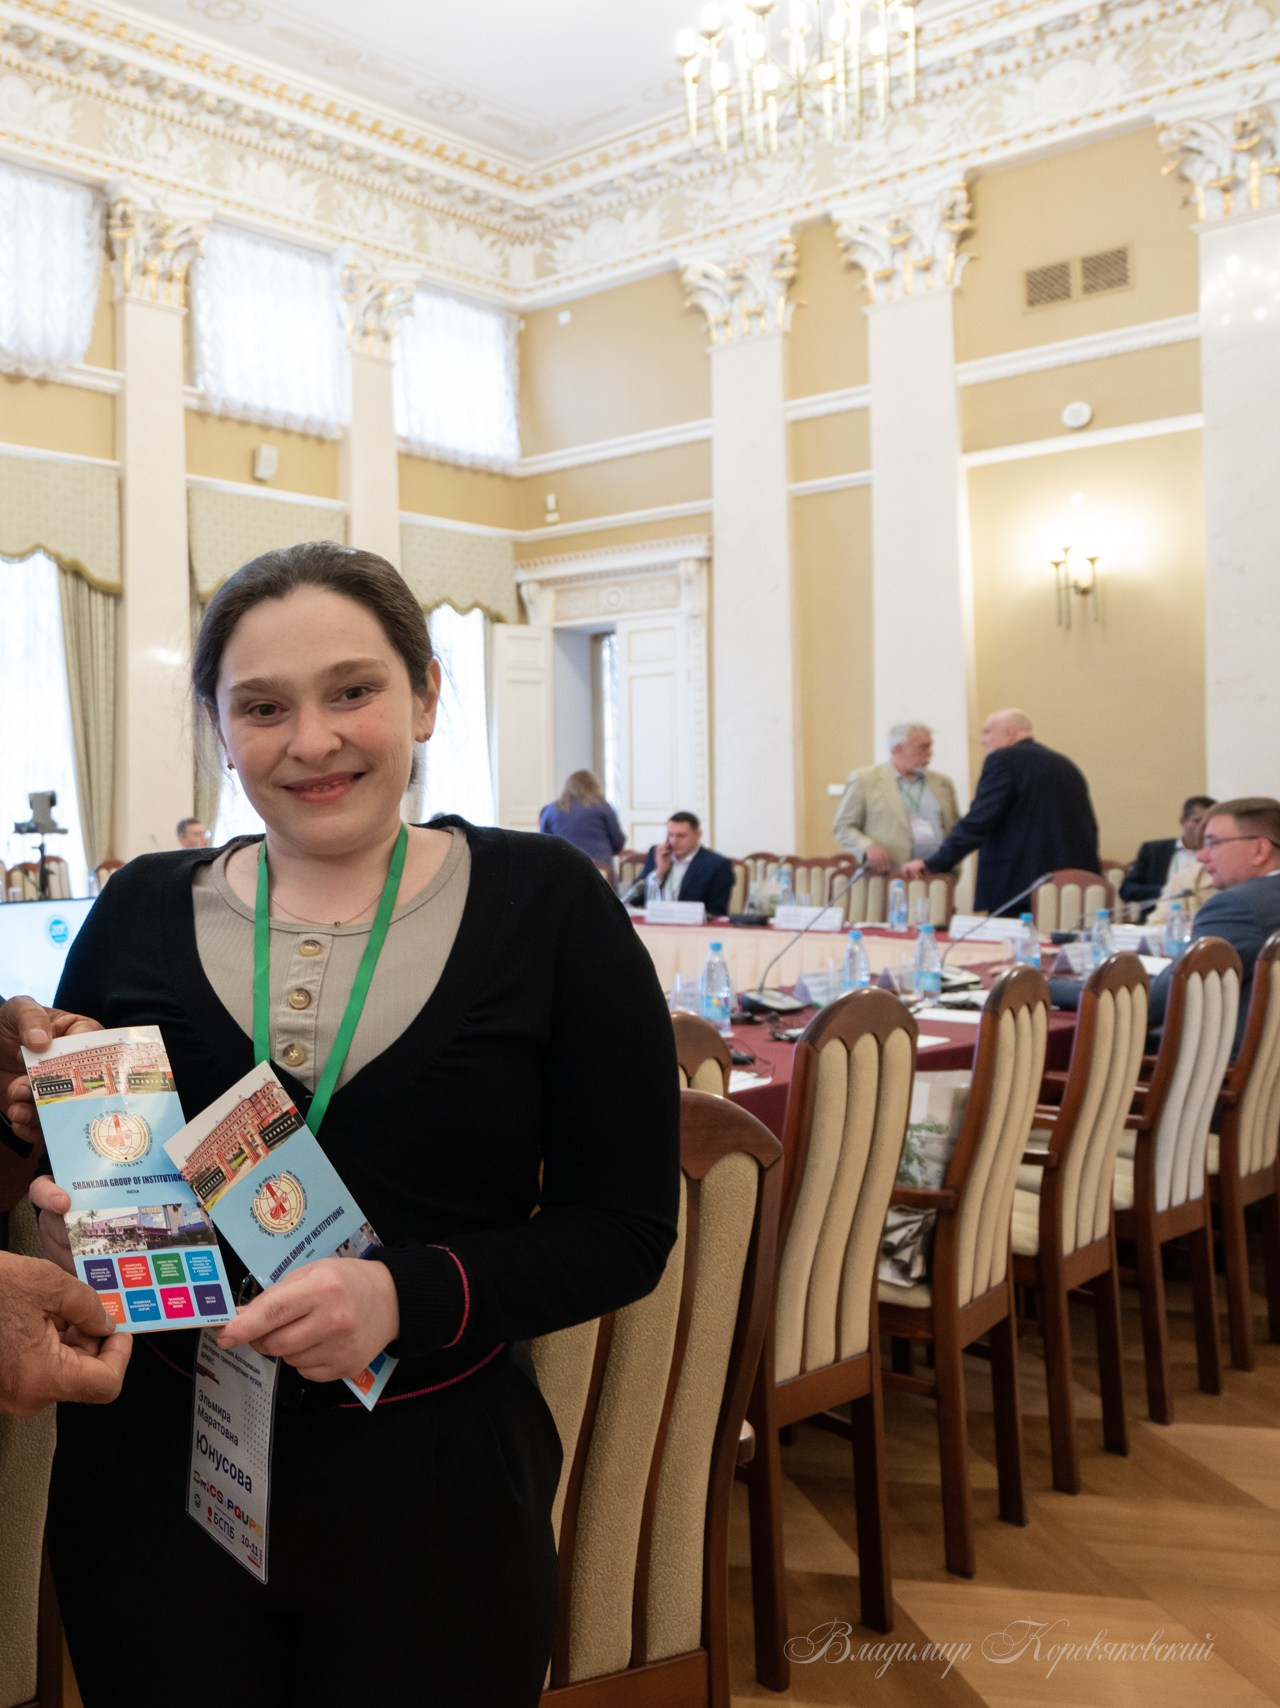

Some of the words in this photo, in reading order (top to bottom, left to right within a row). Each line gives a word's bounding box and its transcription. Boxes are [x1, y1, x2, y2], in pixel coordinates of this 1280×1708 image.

[72, 1179, 109, 1190] SHANKARA
[110, 1177, 131, 1187] GROUP
[133, 1177, 141, 1185] OF
[142, 1173, 185, 1184] INSTITUTION
[269, 1256, 293, 1283] SHANKARA
[290, 1241, 306, 1260] GROUP
[304, 1236, 312, 1245] OF
[312, 1206, 345, 1240] INSTITUTIONS
[198, 1389, 231, 1424] Эльмира
[197, 1404, 239, 1447] Маратовна
[196, 1430, 252, 1494] Юнусова
[213, 1511, 235, 1539] БСПБ
[227, 1498, 263, 1538] PGUPS
[241, 1534, 258, 1557] 10-11
